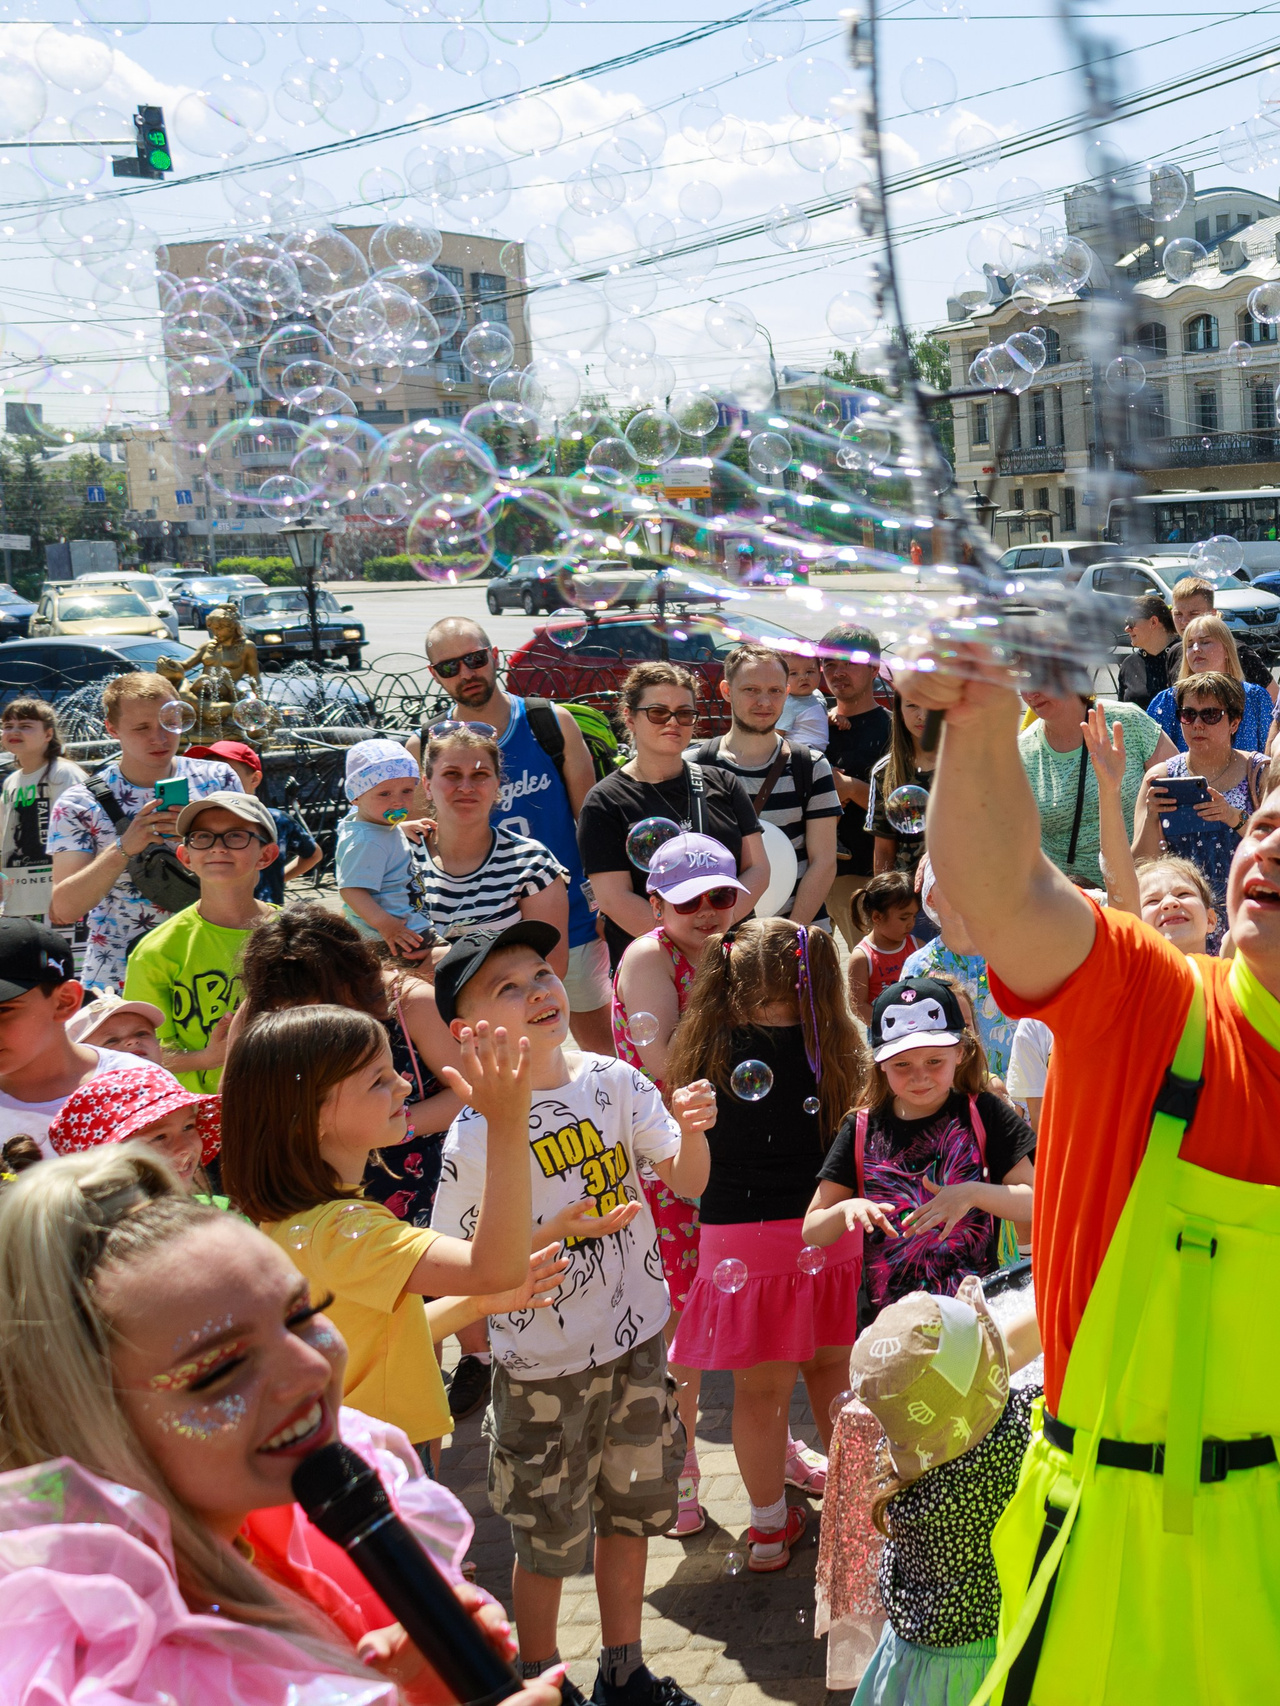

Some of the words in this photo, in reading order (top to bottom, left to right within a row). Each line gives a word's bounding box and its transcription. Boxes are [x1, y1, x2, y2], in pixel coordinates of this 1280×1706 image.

[500, 769, 552, 812] geles
[37, 801, 48, 845] FAILED
[530, 1118, 605, 1178] ПОЛ
[580, 1140, 630, 1196] ЭТО
